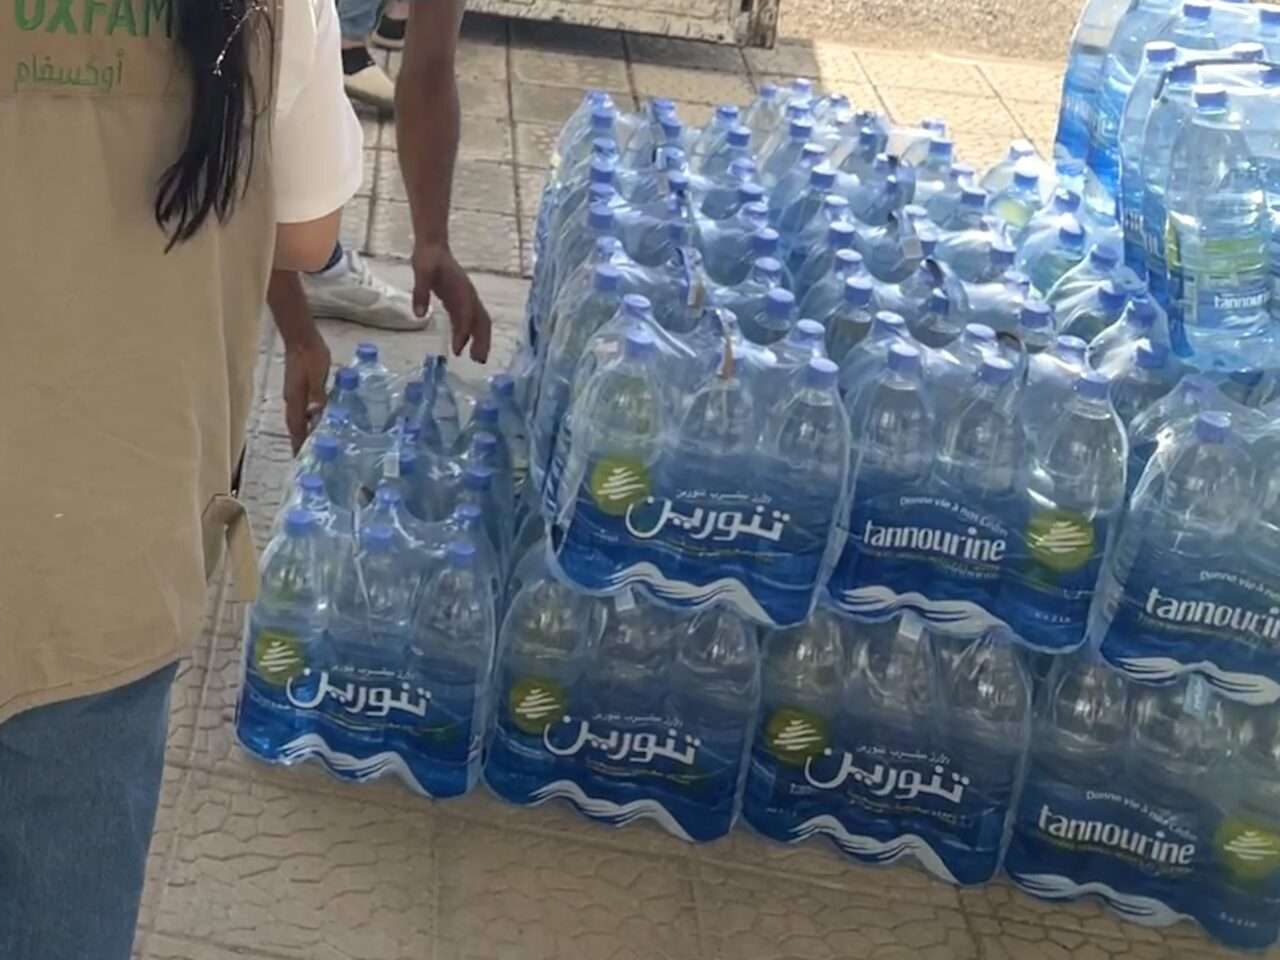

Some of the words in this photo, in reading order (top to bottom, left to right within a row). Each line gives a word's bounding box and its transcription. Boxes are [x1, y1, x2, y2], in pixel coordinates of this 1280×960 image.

[14, 48, 125, 93] أوكسفام
[625, 496, 790, 541] تنورين
[863, 519, 1006, 561] tannourine
[286, 667, 431, 717] تنورين
[543, 715, 701, 765] تنورين
[804, 748, 970, 804] تنورين
[1038, 804, 1195, 865] tannourine
